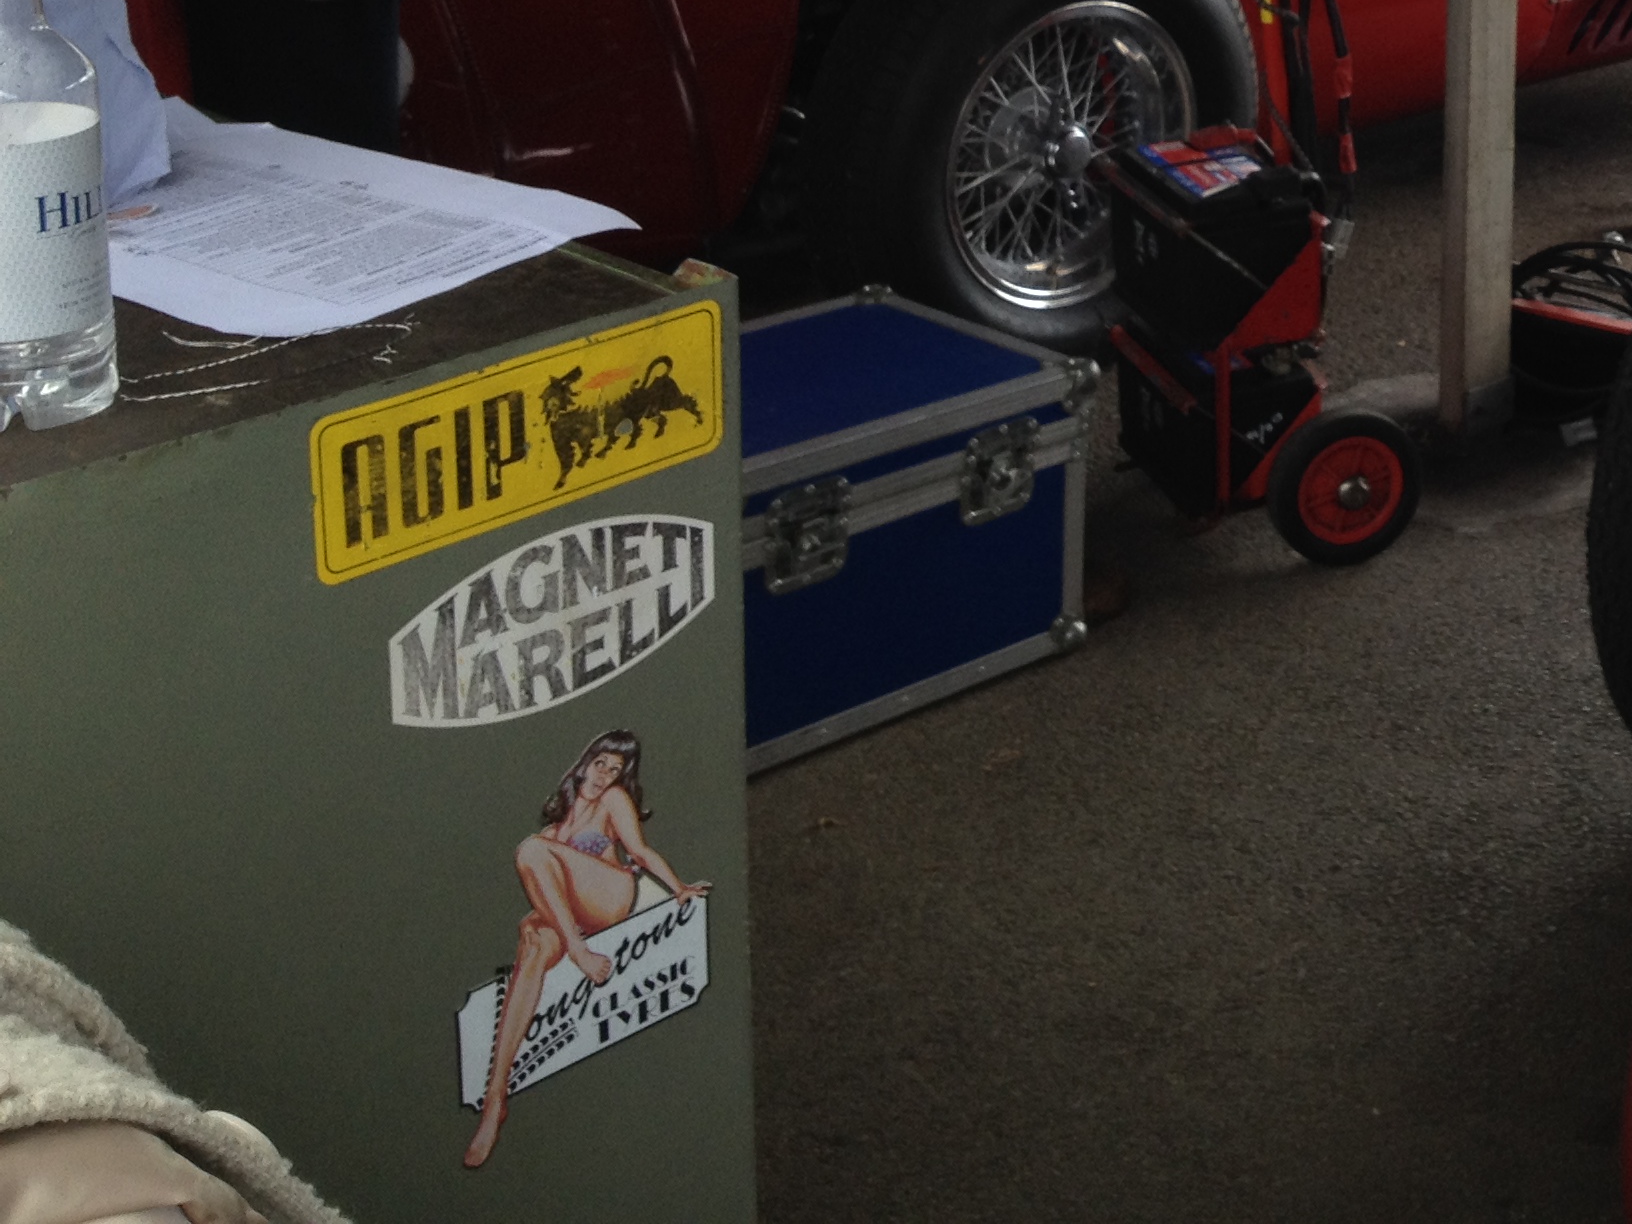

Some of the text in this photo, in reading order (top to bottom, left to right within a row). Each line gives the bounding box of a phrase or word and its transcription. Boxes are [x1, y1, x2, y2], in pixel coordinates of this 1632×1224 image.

[35, 187, 103, 234] HIL
[339, 388, 530, 550] AGIP
[397, 521, 706, 718] MAGNETI
[591, 955, 697, 1020] CLASSIC
[592, 979, 698, 1045] TYRES
